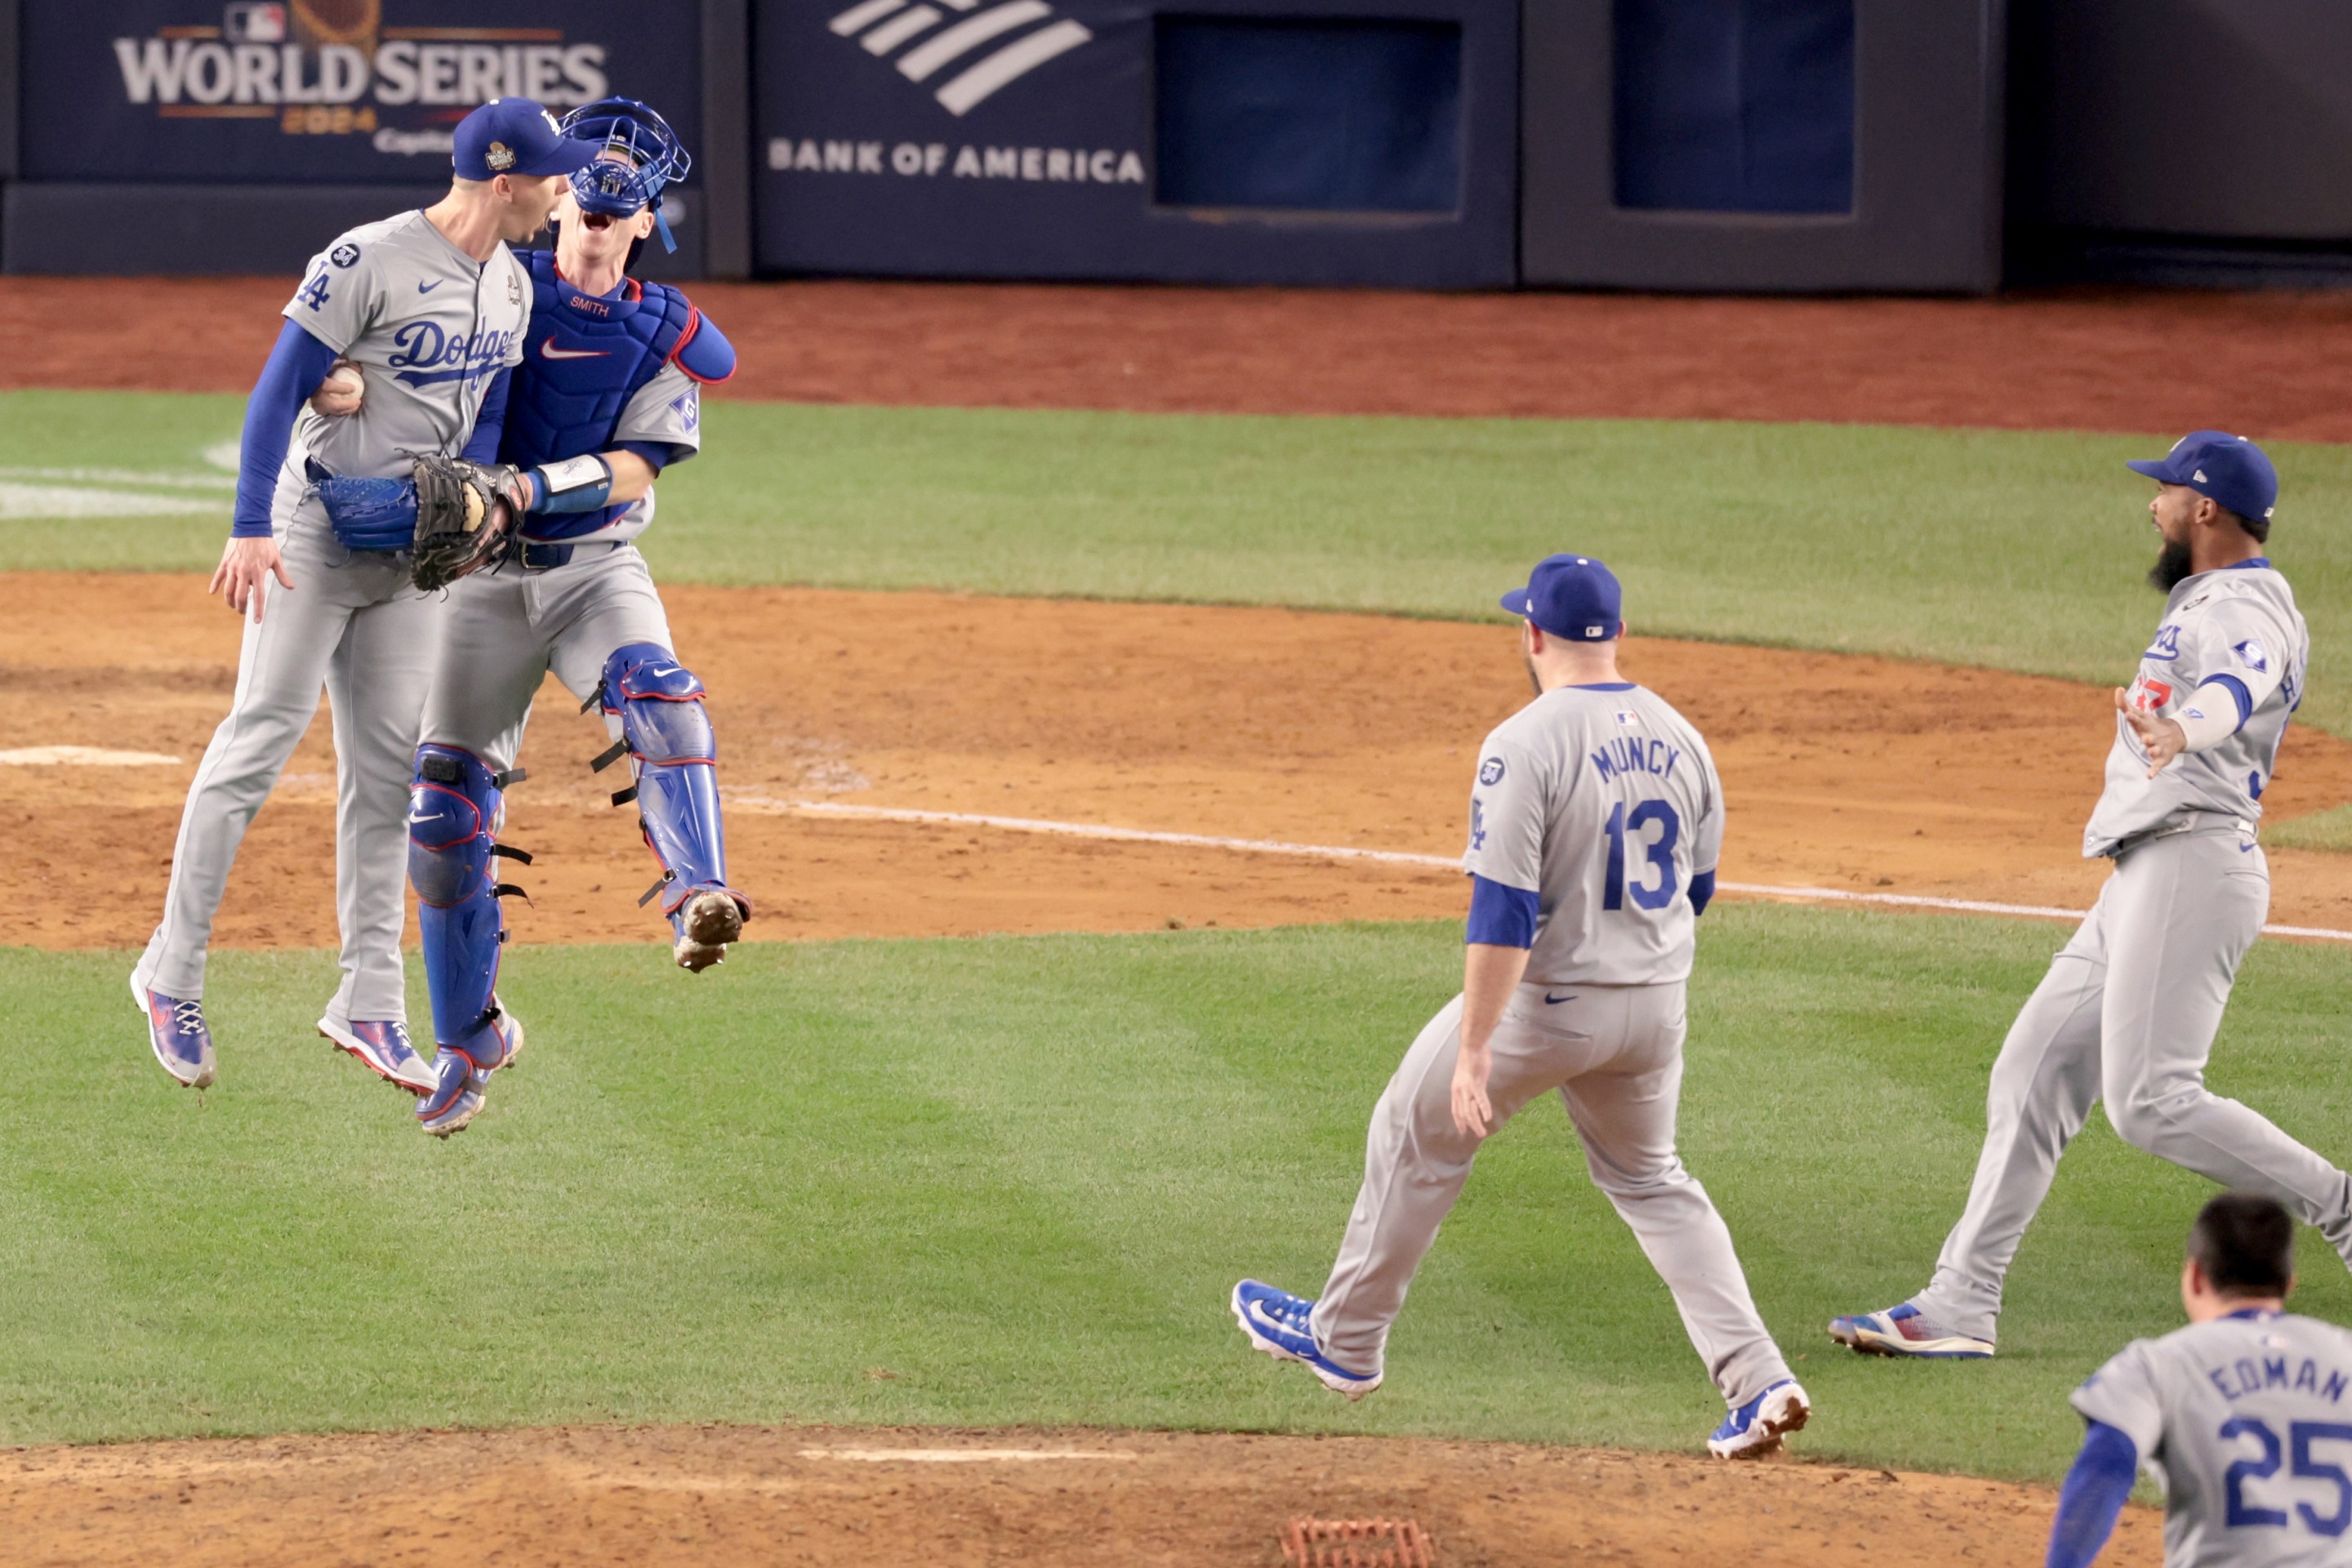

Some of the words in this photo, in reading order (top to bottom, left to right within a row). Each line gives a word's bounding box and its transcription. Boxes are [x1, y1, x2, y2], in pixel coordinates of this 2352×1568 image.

[114, 38, 368, 104] WORLD
[373, 42, 608, 105] SERIES
[282, 107, 376, 134] 2024
[768, 137, 883, 174] BANK
[891, 141, 947, 176] OF
[952, 144, 1145, 185] AMERICA
[333, 249, 353, 266] 34
[297, 261, 331, 313] LA
[570, 296, 610, 318] SMITH
[2183, 708, 2204, 719] 37
[1590, 737, 1680, 784] MUNCY
[1603, 799, 1679, 911] 13
[2209, 1356, 2350, 1403] EDMAN
[2219, 1417, 2352, 1538] 25
